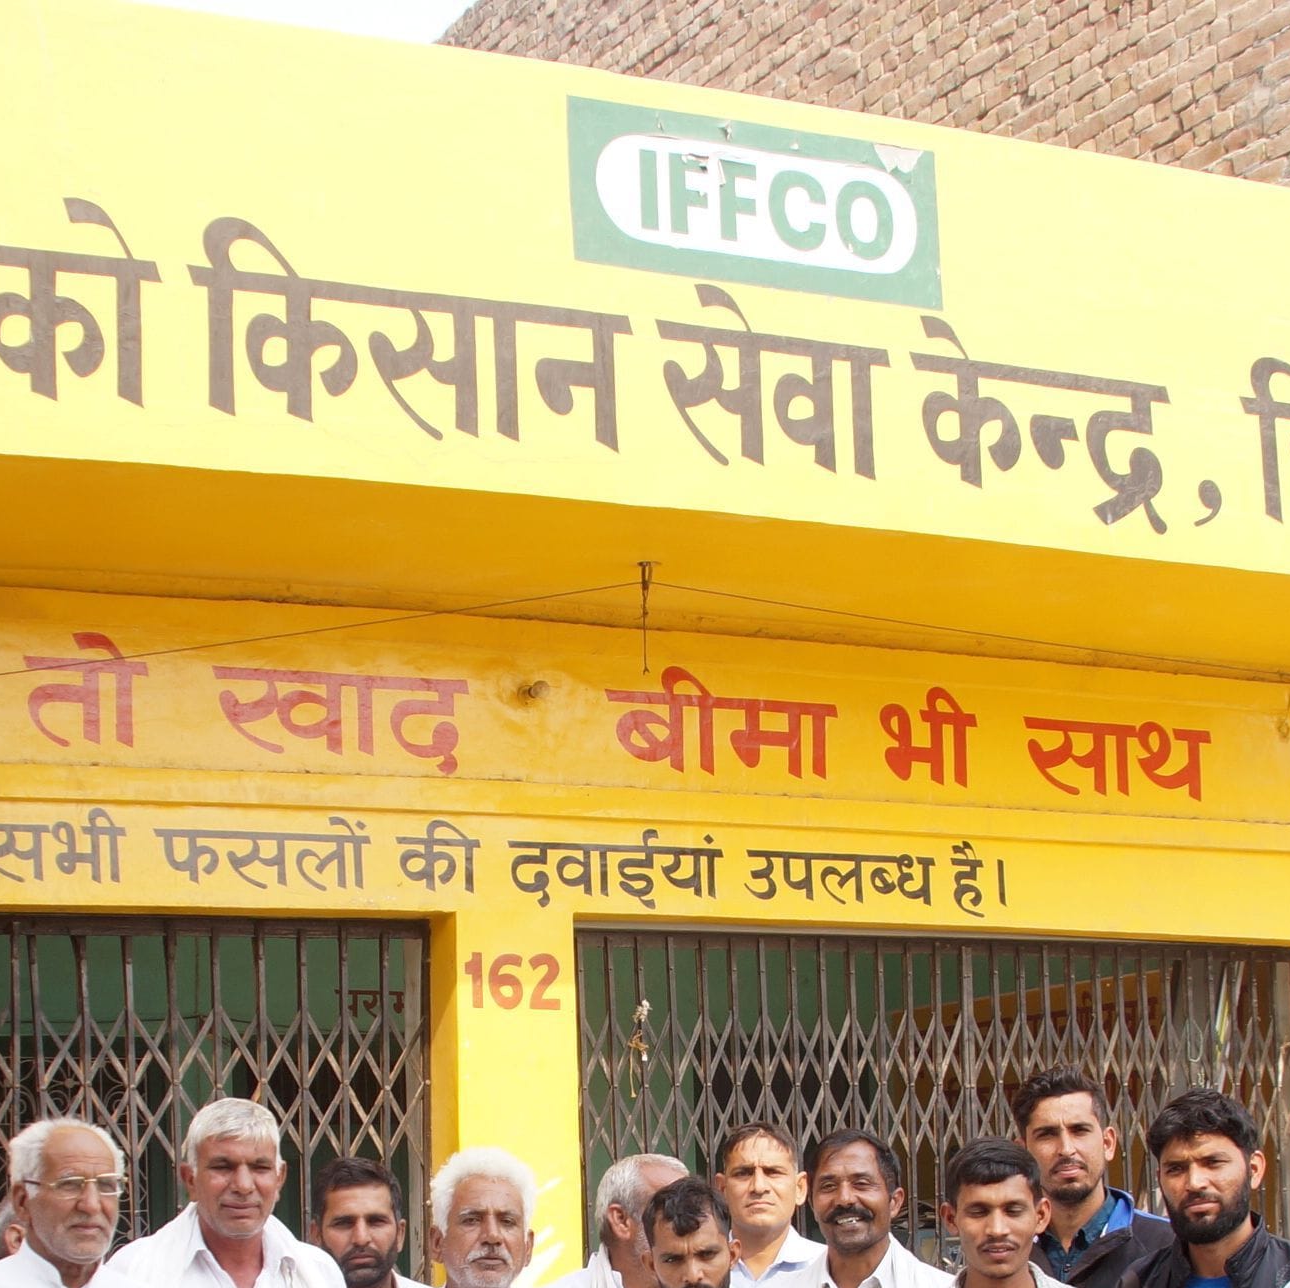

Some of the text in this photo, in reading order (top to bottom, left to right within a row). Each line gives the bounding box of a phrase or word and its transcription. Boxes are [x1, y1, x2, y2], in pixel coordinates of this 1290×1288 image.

[637, 147, 896, 263] IFFCO
[186, 216, 633, 454] किसान
[655, 283, 891, 480] सेवा
[23, 632, 149, 748] तो
[213, 664, 469, 775] खाद
[605, 665, 838, 780] बीमा
[878, 686, 977, 789] भी
[1023, 715, 1212, 801] साथ
[153, 818, 371, 892] फसलों
[395, 820, 480, 894] की
[507, 829, 724, 910] दवाईयां
[744, 848, 936, 906] उपलब्ध
[464, 953, 562, 1011] 162
